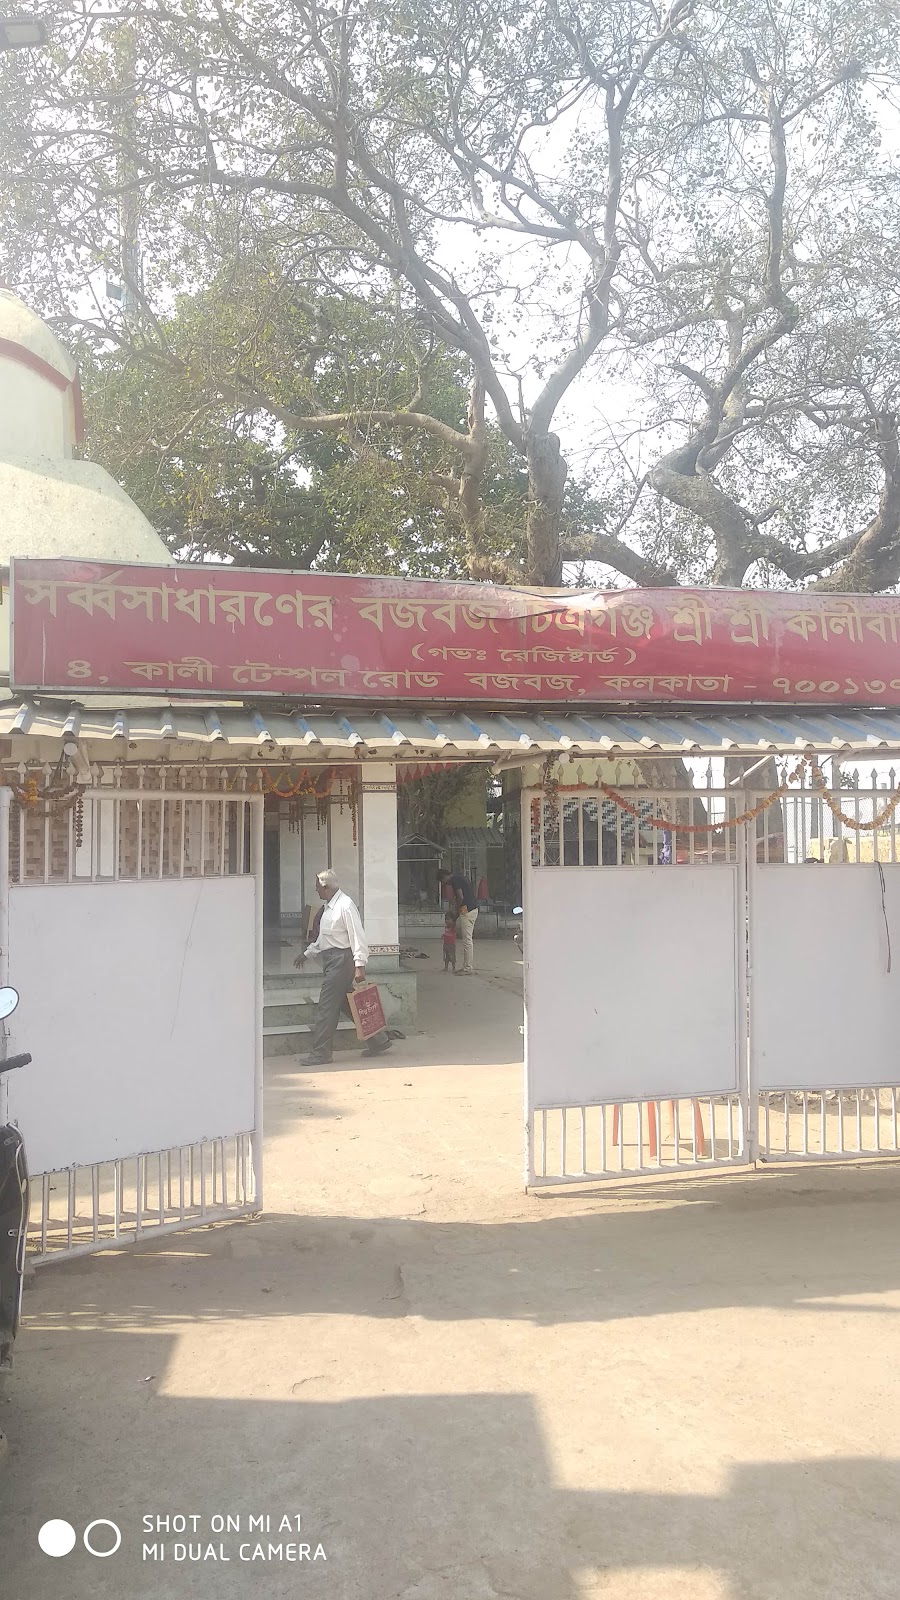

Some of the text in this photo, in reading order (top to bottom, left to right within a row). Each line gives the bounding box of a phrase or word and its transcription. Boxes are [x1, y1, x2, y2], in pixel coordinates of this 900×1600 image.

[349, 597, 503, 634] বজবজ
[665, 593, 717, 646] শ্রী
[721, 596, 770, 647] শ্রী
[780, 599, 900, 644] কালীবা
[123, 656, 220, 683] কালী
[228, 659, 351, 687] টেম্পল
[357, 669, 445, 689] রোড
[463, 672, 586, 696] বজবজ,
[598, 673, 735, 693] কলকাতা
